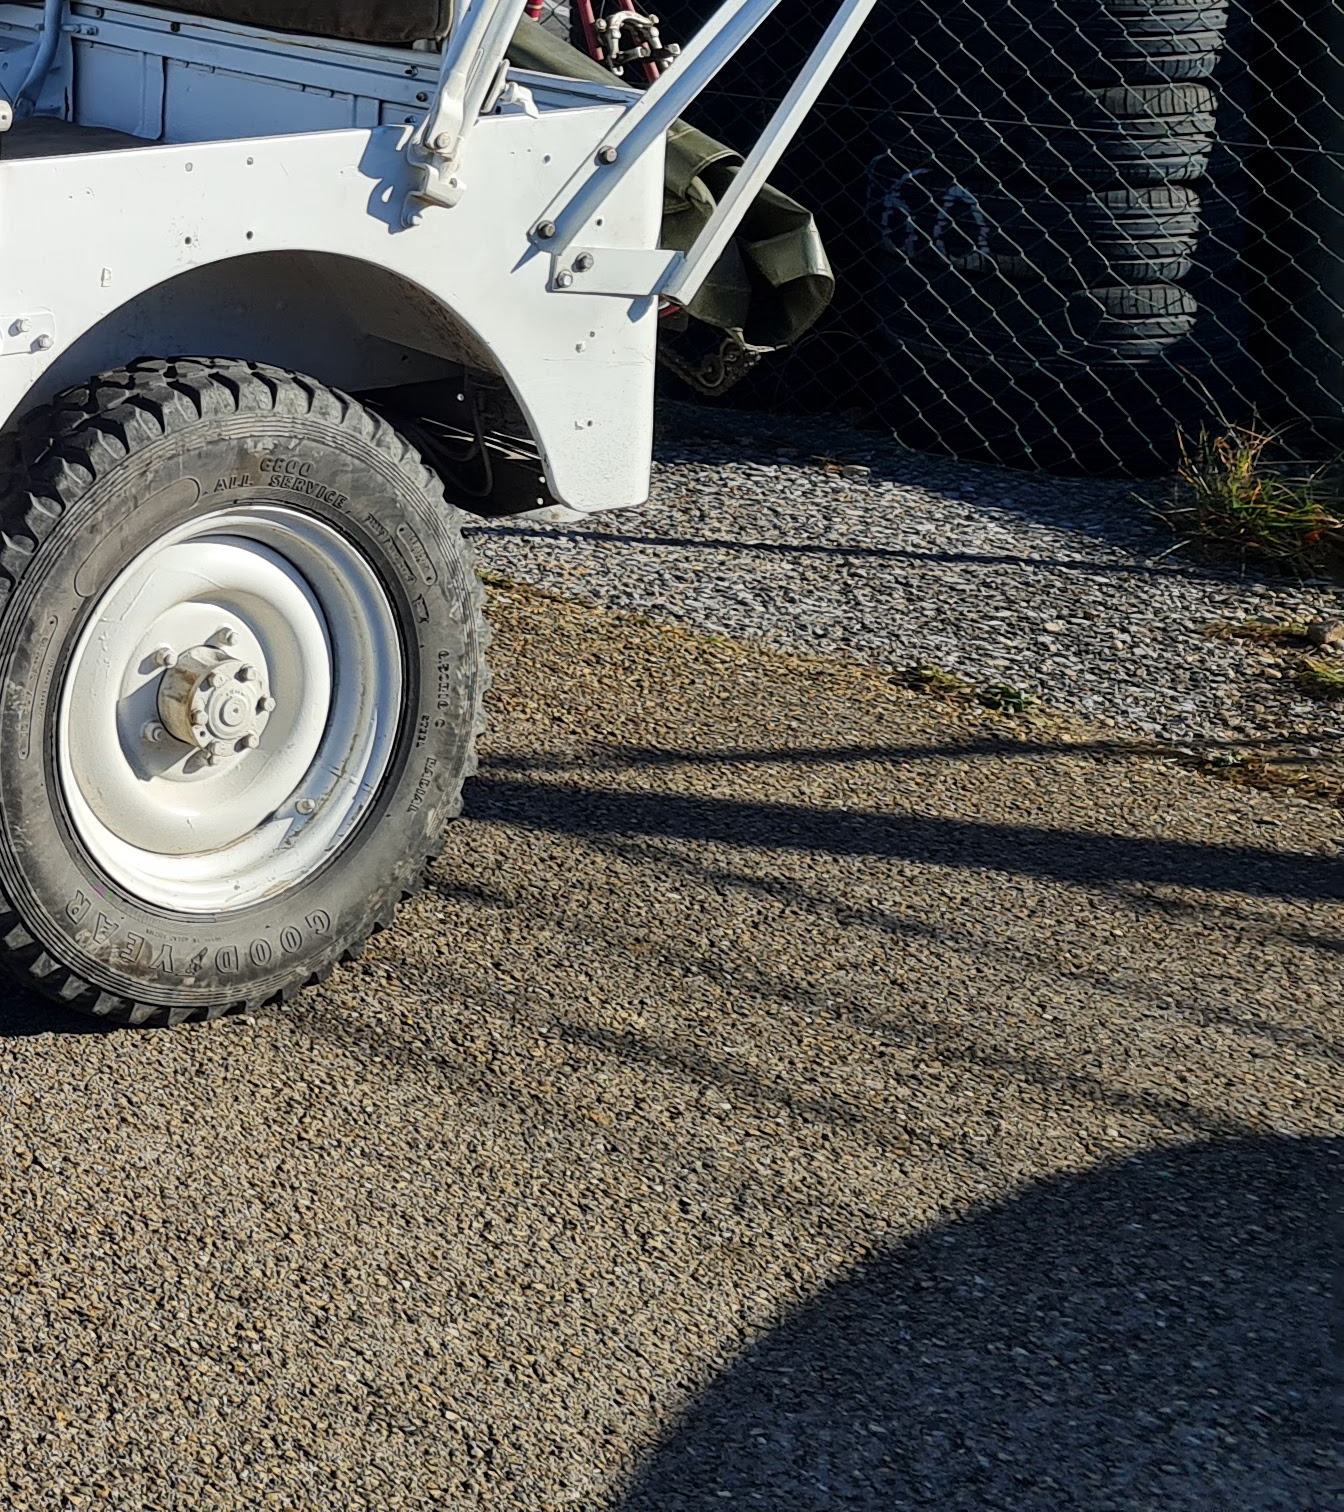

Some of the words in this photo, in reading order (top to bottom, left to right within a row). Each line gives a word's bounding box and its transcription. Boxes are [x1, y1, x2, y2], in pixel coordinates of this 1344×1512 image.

[213, 473, 255, 493] ALL
[267, 473, 349, 509] SERVICE
[406, 756, 438, 813] RADIAL
[64, 889, 332, 975] GOODYEAR
